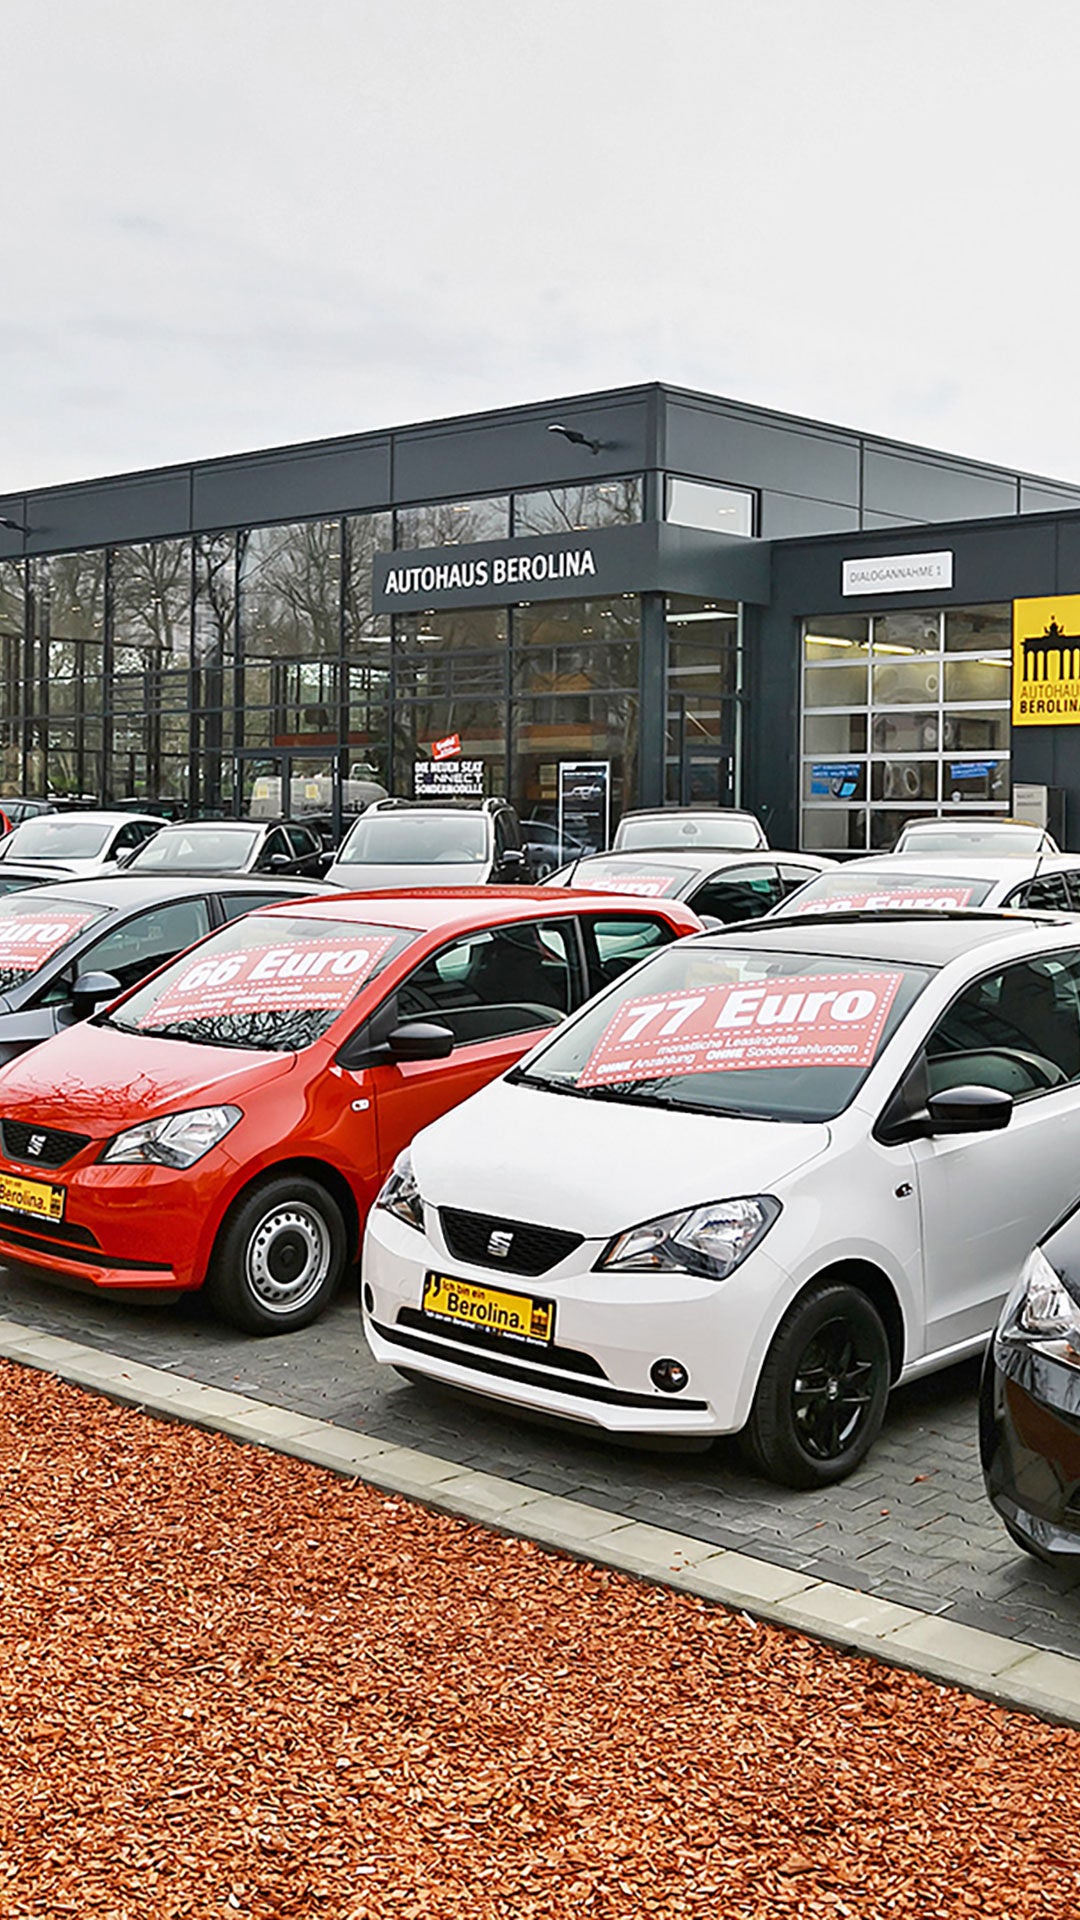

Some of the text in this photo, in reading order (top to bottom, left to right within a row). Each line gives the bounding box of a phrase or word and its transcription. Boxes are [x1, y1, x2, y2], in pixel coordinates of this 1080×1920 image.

[385, 550, 596, 594] AUTOHAUS BEROLINA
[850, 565, 934, 583] DIALOGANNAHME
[1020, 683, 1080, 699] AUTOHAU
[1020, 699, 1080, 714] BEROLIN
[461, 761, 484, 773] SEAT
[414, 783, 484, 795] SONDERMODELLE
[177, 949, 370, 992] 66 Euro
[619, 988, 877, 1042] 77 Euro
[657, 1033, 799, 1055] monatliche Leasingrate
[597, 1042, 859, 1075] OHNE Anzahlung OHNE Sonderzahlungen
[457, 1284, 470, 1296] bin
[472, 1288, 486, 1300] ein
[447, 1292, 525, 1330] Berolina.
